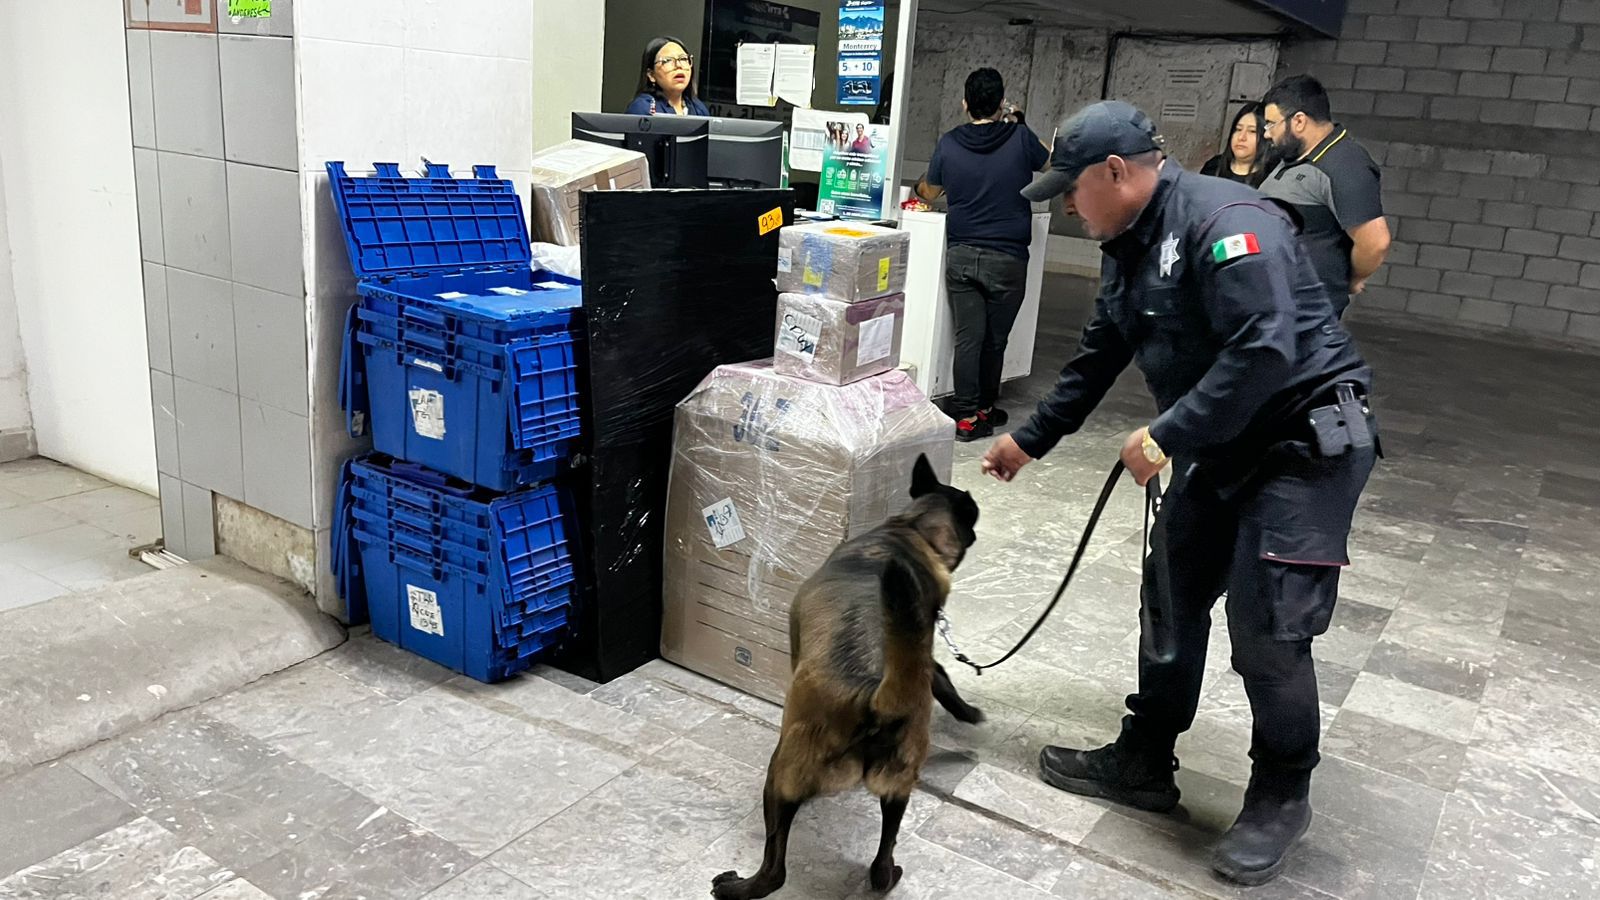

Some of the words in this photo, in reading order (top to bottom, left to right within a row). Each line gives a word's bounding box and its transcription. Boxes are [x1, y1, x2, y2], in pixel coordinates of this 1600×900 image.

[843, 43, 878, 51] Monterrey
[842, 62, 848, 72] 5
[862, 62, 873, 72] 10
